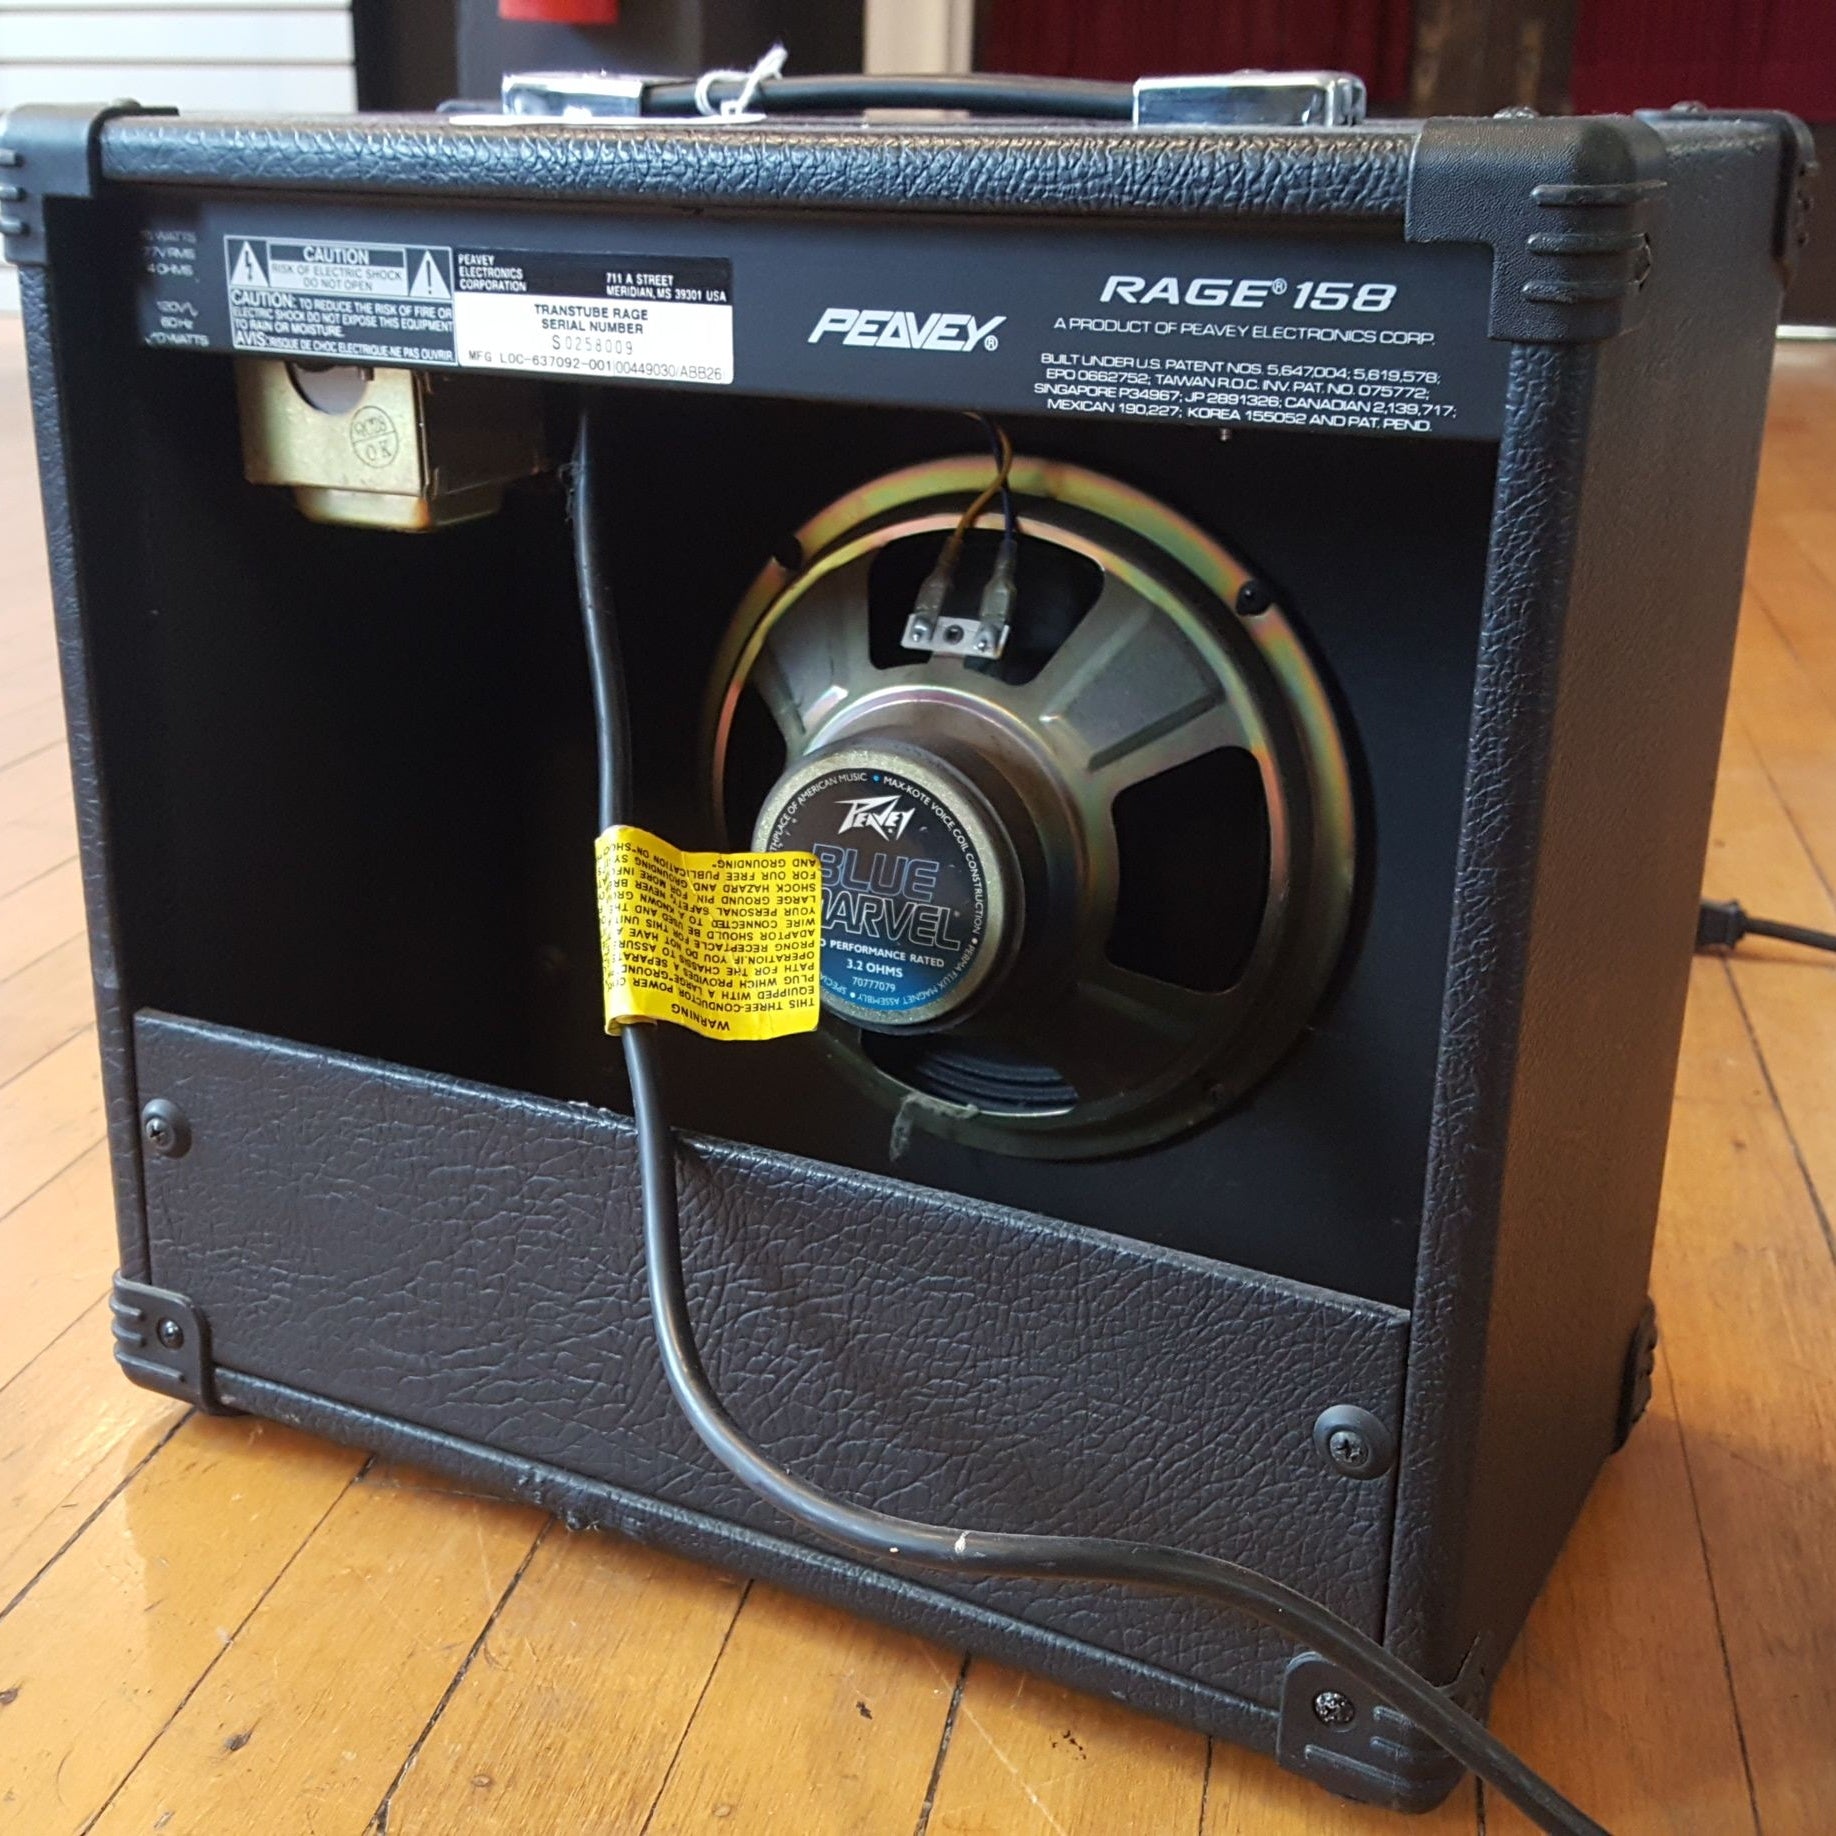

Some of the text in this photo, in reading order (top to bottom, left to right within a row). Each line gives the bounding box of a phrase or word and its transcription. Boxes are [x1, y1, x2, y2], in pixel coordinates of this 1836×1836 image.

[303, 246, 369, 265] CAUTION
[458, 254, 495, 266] PEAVEY
[271, 262, 401, 281] RISK OF ELECTRIC SHOCK
[459, 266, 524, 280] ELECTRONICS
[606, 272, 674, 286] 711 A STREET
[302, 277, 372, 291] DO NOT OPEN
[459, 278, 528, 292] CORPORATION
[606, 285, 727, 302] MERIDIAN, MS 39301 USA
[1293, 281, 1397, 312] 158
[231, 289, 298, 308] CAUTION:
[398, 304, 412, 317] OF
[414, 305, 436, 319] FIRE
[437, 307, 453, 320] OR
[534, 304, 648, 320] TRANSTUBE RAGE
[379, 316, 400, 329] THIS
[401, 318, 454, 332] EQUIPMENT
[541, 318, 643, 334] SERIAL NUMBER
[1053, 317, 1436, 346] A PRODUCT OF PEAVEY ELECTRONICS CORP.
[468, 350, 492, 362] MFG
[1040, 353, 1078, 365] BUILT
[1081, 355, 1134, 369] UNDER
[1165, 359, 1225, 373] PATENT
[1046, 368, 1076, 380] EPO
[1155, 374, 1216, 388] TAIWAN
[1262, 380, 1290, 392] INV.
[1293, 381, 1325, 394] PAT.
[1327, 383, 1355, 396] NO.
[1033, 382, 1117, 398] SINGAPORE
[1184, 391, 1205, 403] JP
[1284, 397, 1371, 413] CANADIAN
[1047, 398, 1115, 413] MEXICAN
[1187, 407, 1241, 421] KOREA
[1245, 410, 1307, 425] 155052
[1309, 414, 1346, 427] AND
[1348, 416, 1380, 429] PAT.
[1383, 418, 1432, 432] PEND.
[788, 773, 867, 814] OF AMERICAN MUSIC
[883, 776, 983, 934] MAX-KOTE VOICE COIL CONSTRUCTION
[653, 855, 815, 880] FOR OUR FREE PUBLICATION
[792, 859, 816, 867] AND
[635, 857, 815, 893] SHOCK HAZARD AND GROUNDING
[812, 843, 940, 903] BLUE
[722, 896, 769, 904] GROUND
[777, 896, 815, 904] LARGE
[716, 908, 777, 916] PERSONAL
[784, 908, 815, 916] YOUR
[635, 905, 814, 941] ADAPTOR SHOULD BE AND
[646, 919, 668, 932] THIS
[690, 916, 703, 926] TO
[712, 920, 777, 929] CONNECTED
[786, 918, 815, 928] WIRE
[629, 928, 658, 940] HAVE
[686, 948, 698, 958] DO
[694, 940, 768, 952] RECEPTACLE
[775, 940, 814, 951] PRONG
[704, 954, 727, 963] YOU
[830, 940, 944, 968] PERFORMANCE RATED
[663, 948, 814, 976] PATH FOR THE TO
[846, 959, 903, 978] 3.2 OHMS
[633, 978, 673, 993] POWER
[740, 978, 777, 988] WHICH
[784, 974, 814, 984] PLUG
[852, 977, 896, 992] 70777079
[679, 989, 783, 1012] THREE-CONDUCTOR
[708, 986, 814, 1000] EQUIPPED WITH A
[789, 998, 814, 1008] THIS
[671, 1003, 730, 1031] WARNING
